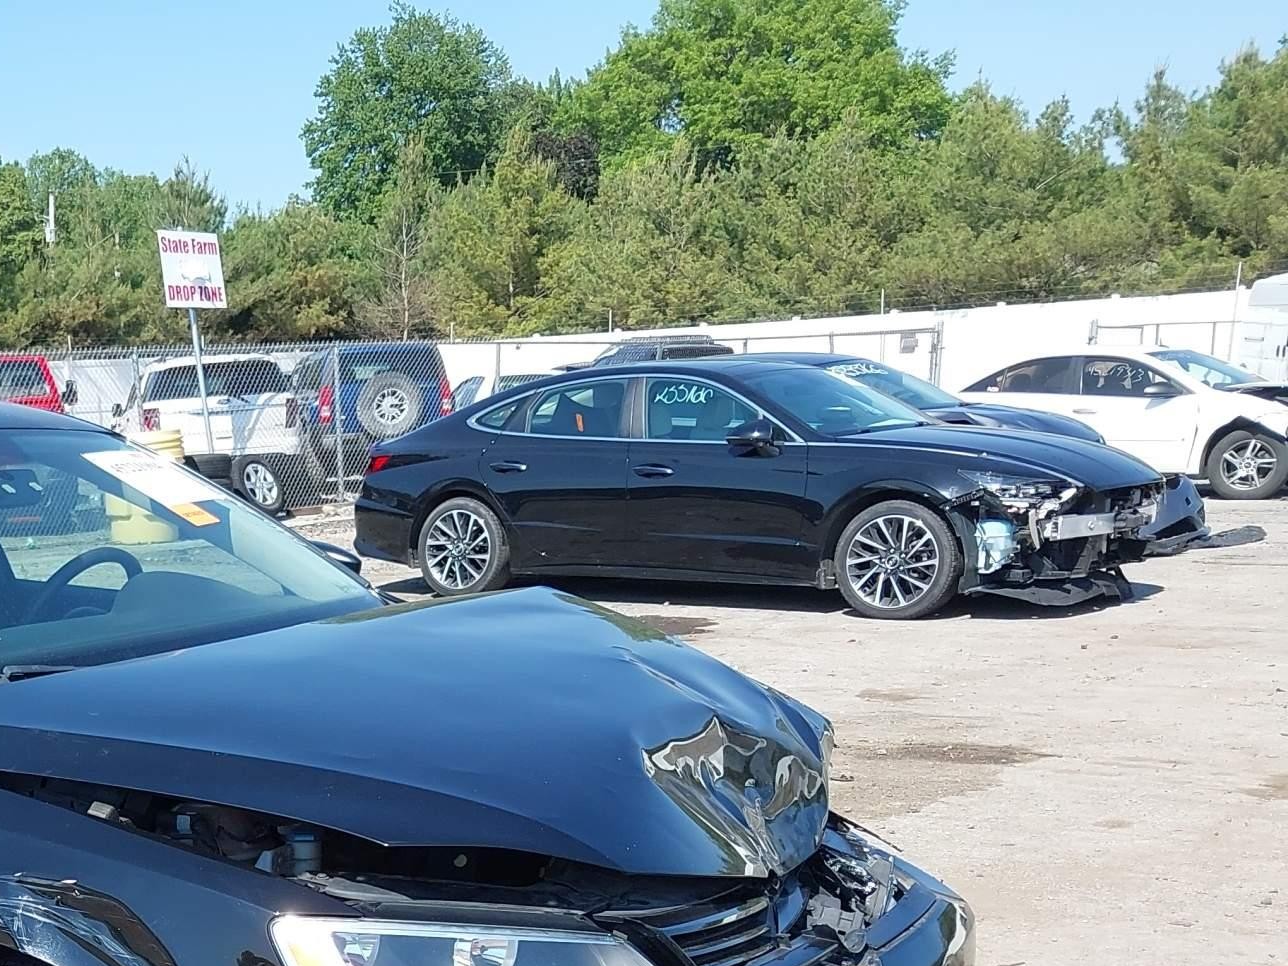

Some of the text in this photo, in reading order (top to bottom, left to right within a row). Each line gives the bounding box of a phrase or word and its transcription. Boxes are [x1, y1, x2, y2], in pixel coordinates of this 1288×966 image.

[161, 236, 218, 256] State Farm
[168, 284, 224, 302] DROP ZONE
